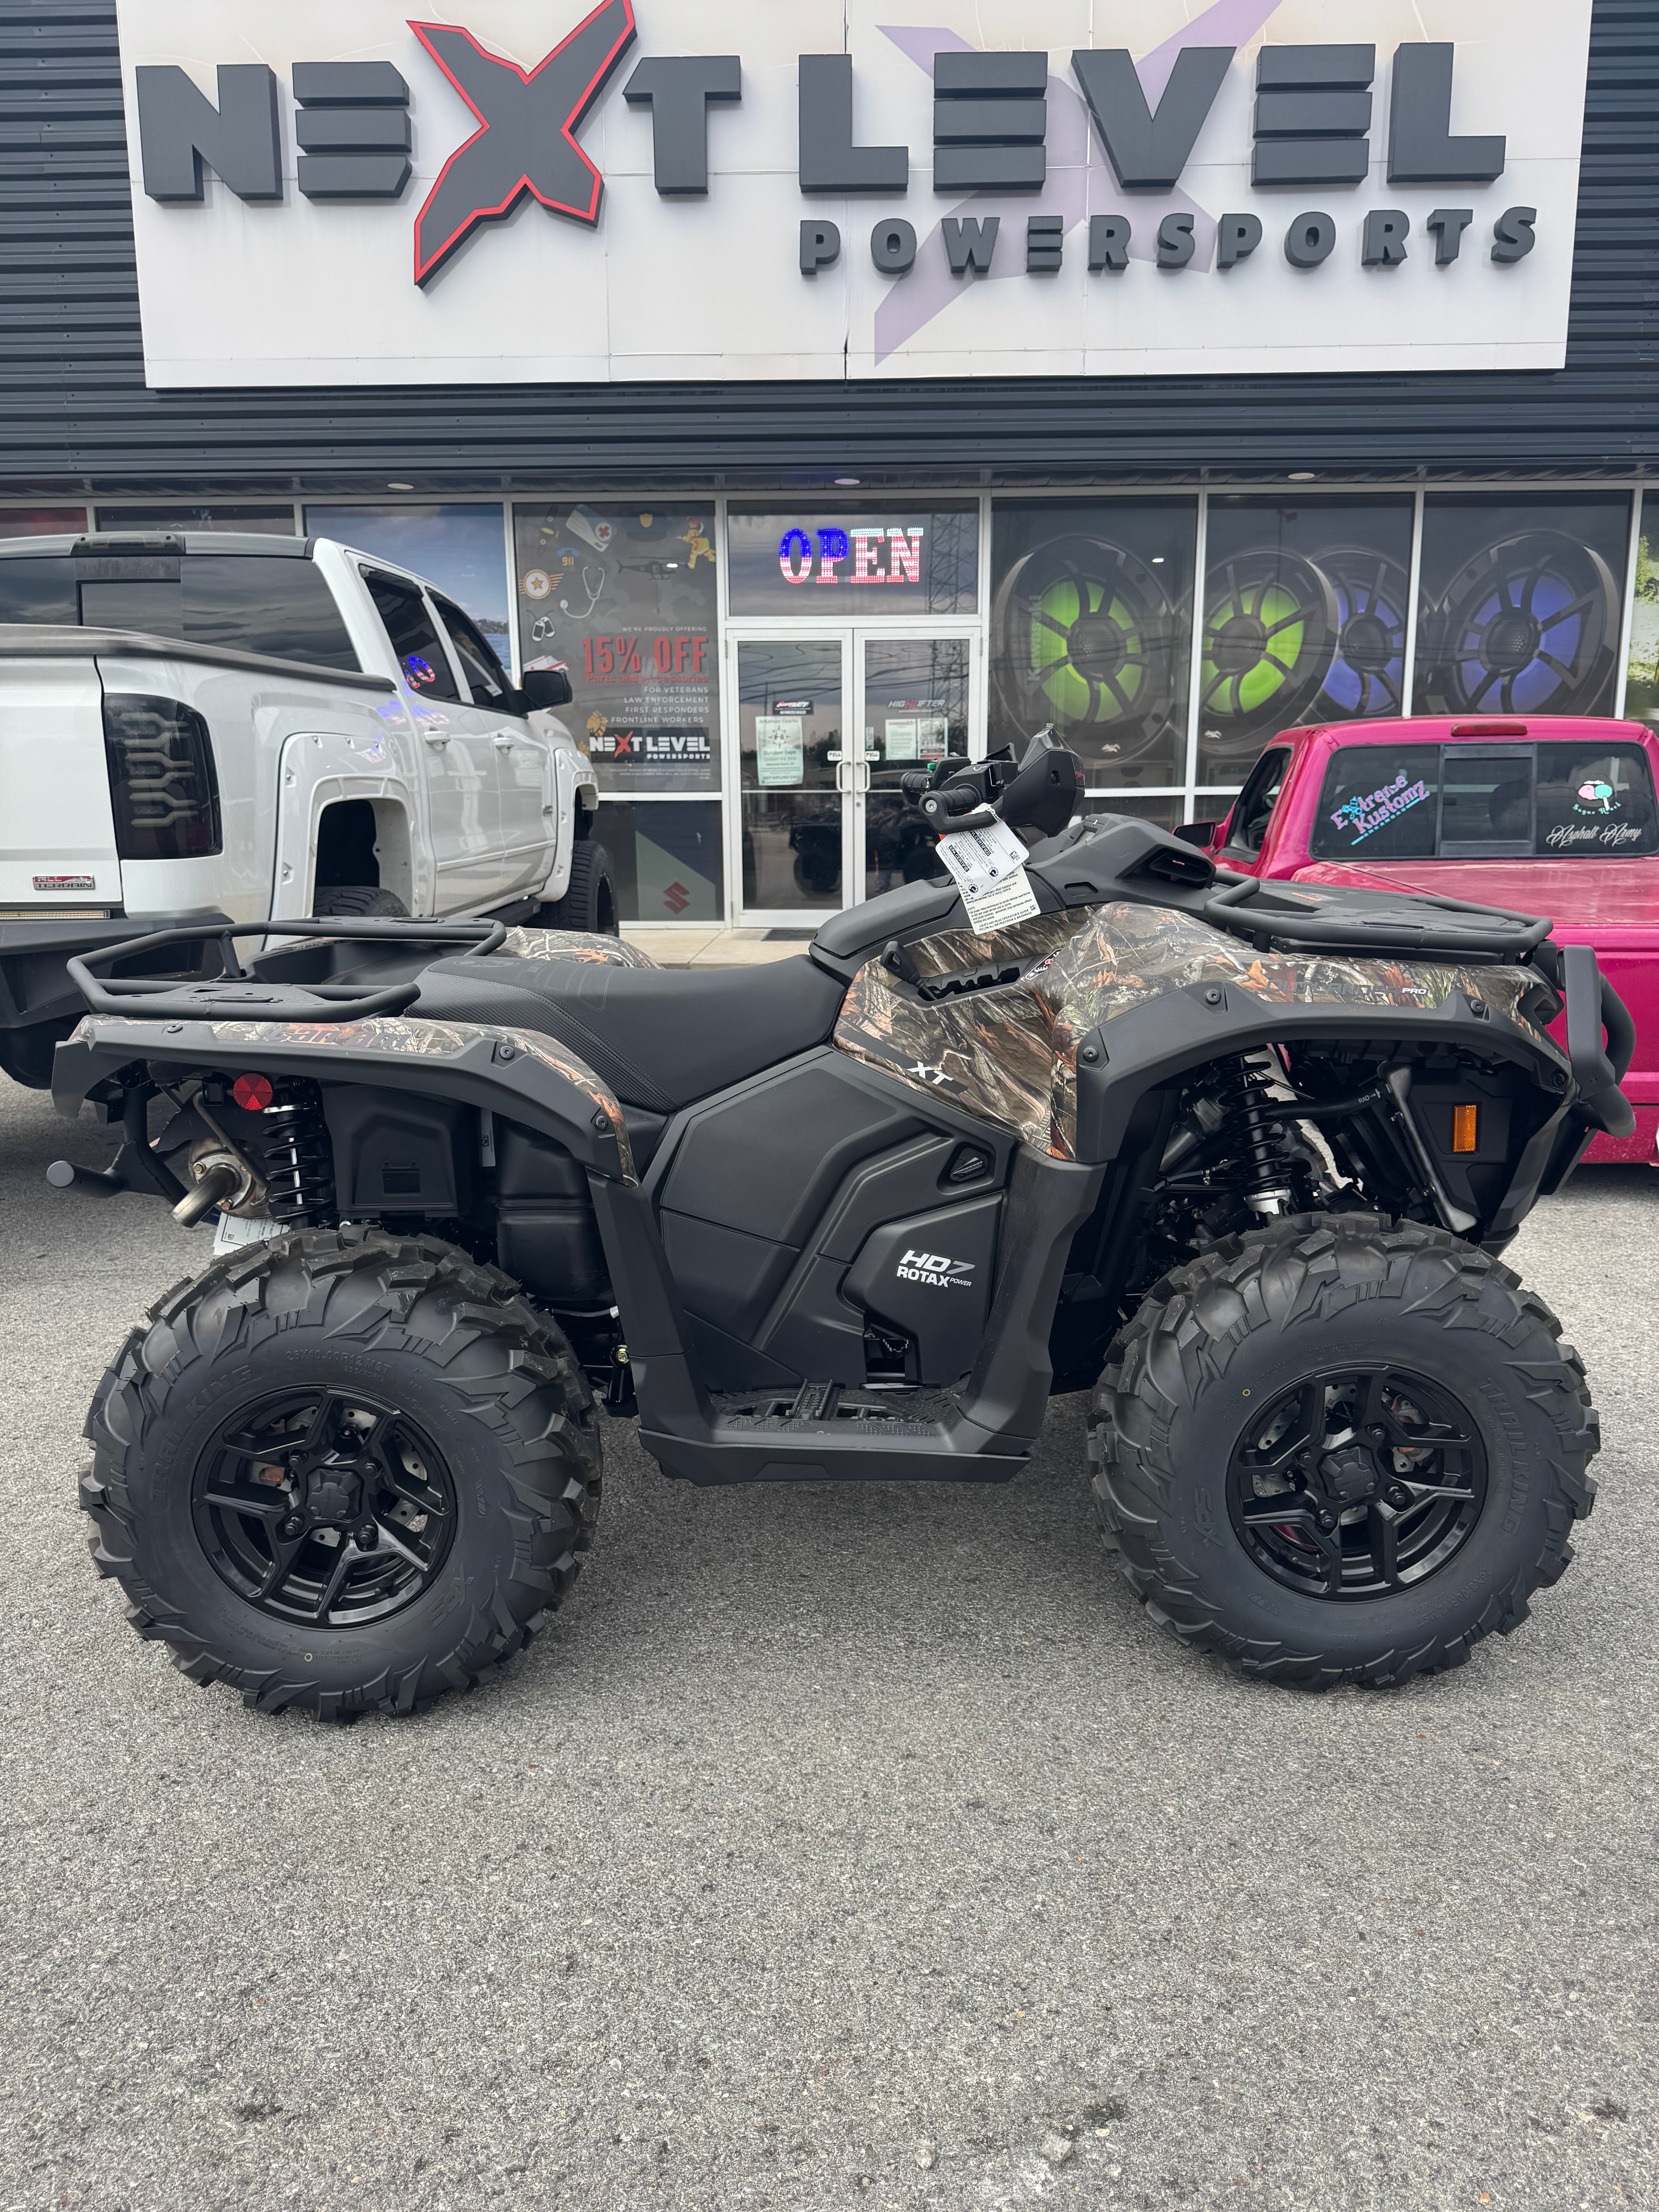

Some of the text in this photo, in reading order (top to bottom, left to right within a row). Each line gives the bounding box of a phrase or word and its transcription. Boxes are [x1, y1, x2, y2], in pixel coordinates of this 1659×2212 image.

[136, 0, 1506, 288] NEXT LEVEL
[799, 207, 1537, 275] POWERSPORTS
[562, 557, 574, 566] 911
[779, 527, 923, 583] OPEN
[1028, 595, 1042, 680] Kawasaki
[581, 636, 707, 673] 15% OFF
[586, 675, 615, 683] Parts
[589, 731, 711, 758] NEXT LEVEL
[1352, 780, 1431, 834] Kustomz
[1573, 804, 1595, 815] Sugar
[973, 835, 991, 856] CERTIFIED
[1546, 823, 1642, 848] Asphalt Army
[1266, 979, 1400, 997] OUTLANDER
[907, 1061, 954, 1085] XT
[1358, 1095, 1370, 1104] RAD
[900, 1250, 975, 1274] HD7
[896, 1266, 972, 1287] ROTAX POWER
[149, 1420, 190, 1502] TRAIL
[1479, 1377, 1530, 1536] TRAIL KING
